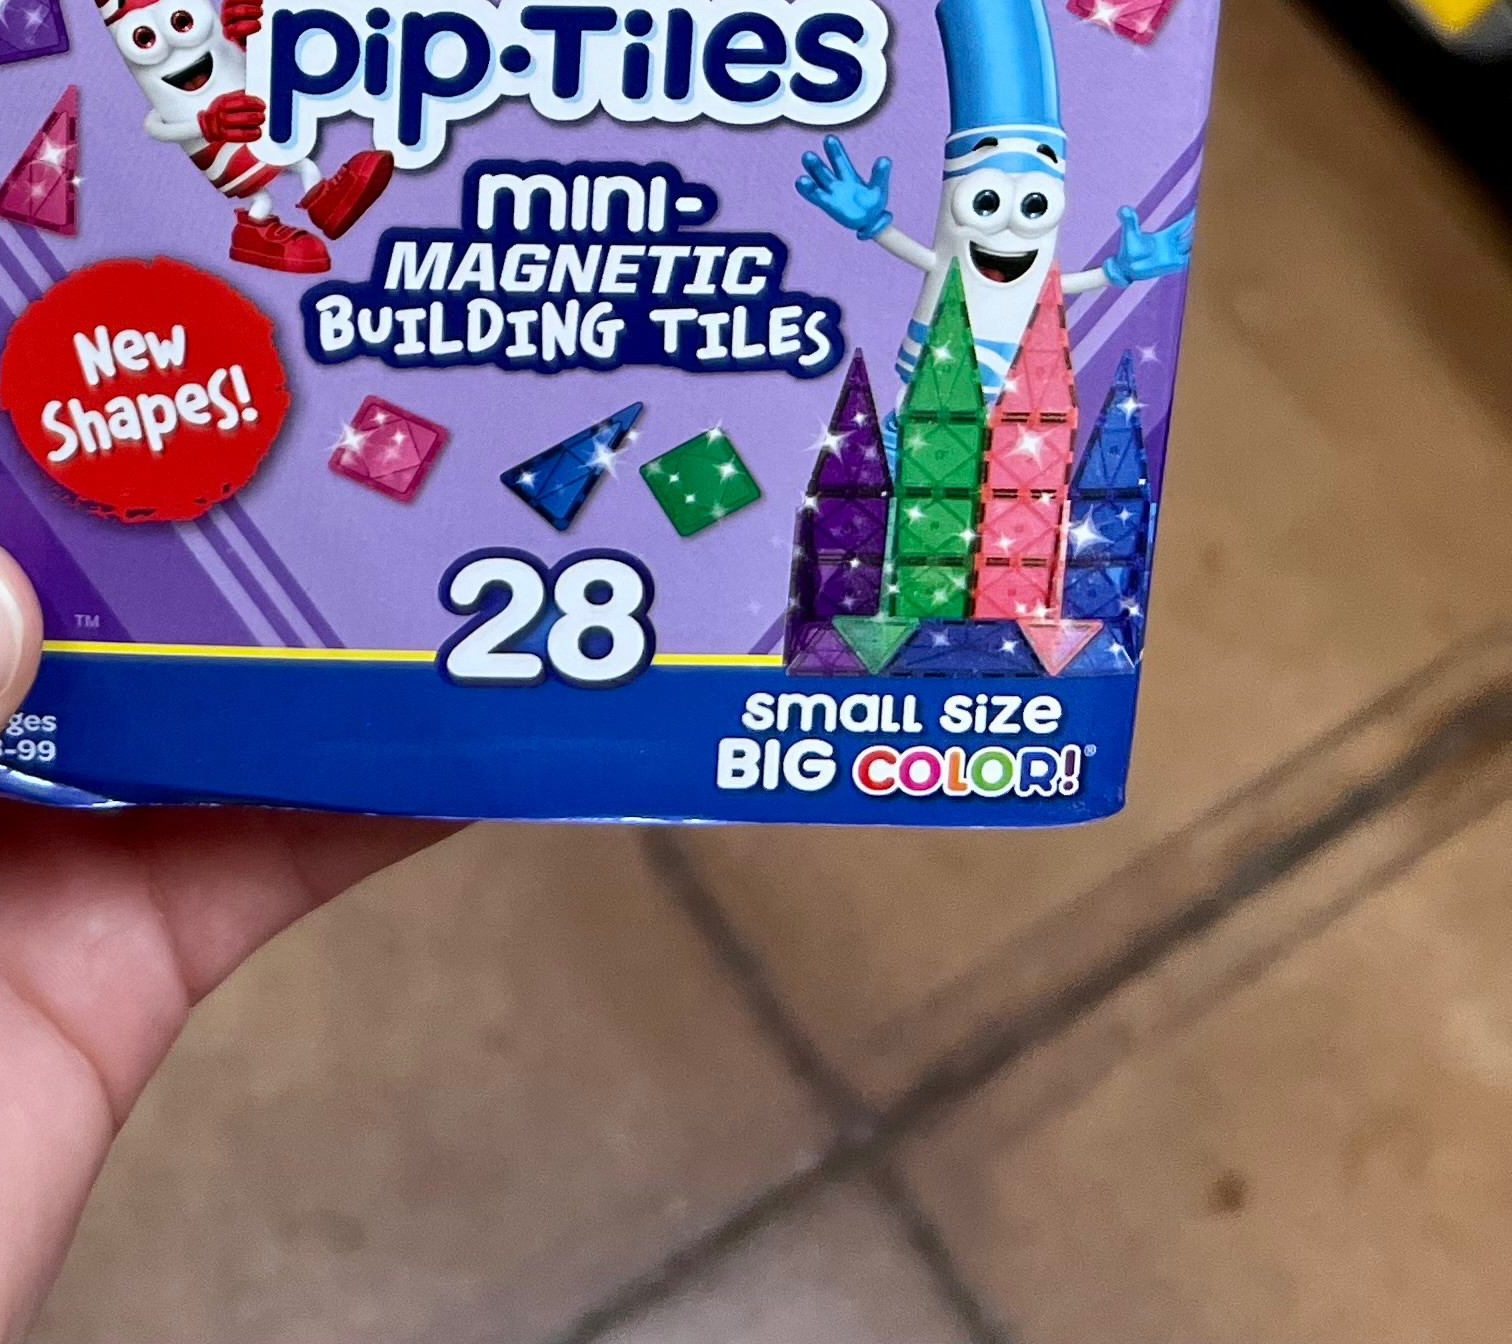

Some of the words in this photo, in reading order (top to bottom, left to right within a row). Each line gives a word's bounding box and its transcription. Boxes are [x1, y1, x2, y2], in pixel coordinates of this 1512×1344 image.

[477, 174, 703, 232] mini-
[383, 242, 772, 294] MAGNETIC
[72, 323, 186, 386] New
[314, 294, 624, 360] BUILDING
[648, 305, 828, 368] TILES
[41, 364, 259, 465] Shapes!
[446, 558, 644, 682] 28
[6, 712, 57, 736] ges
[741, 692, 922, 733] small
[940, 693, 1062, 734] size
[717, 738, 837, 791] BIG
